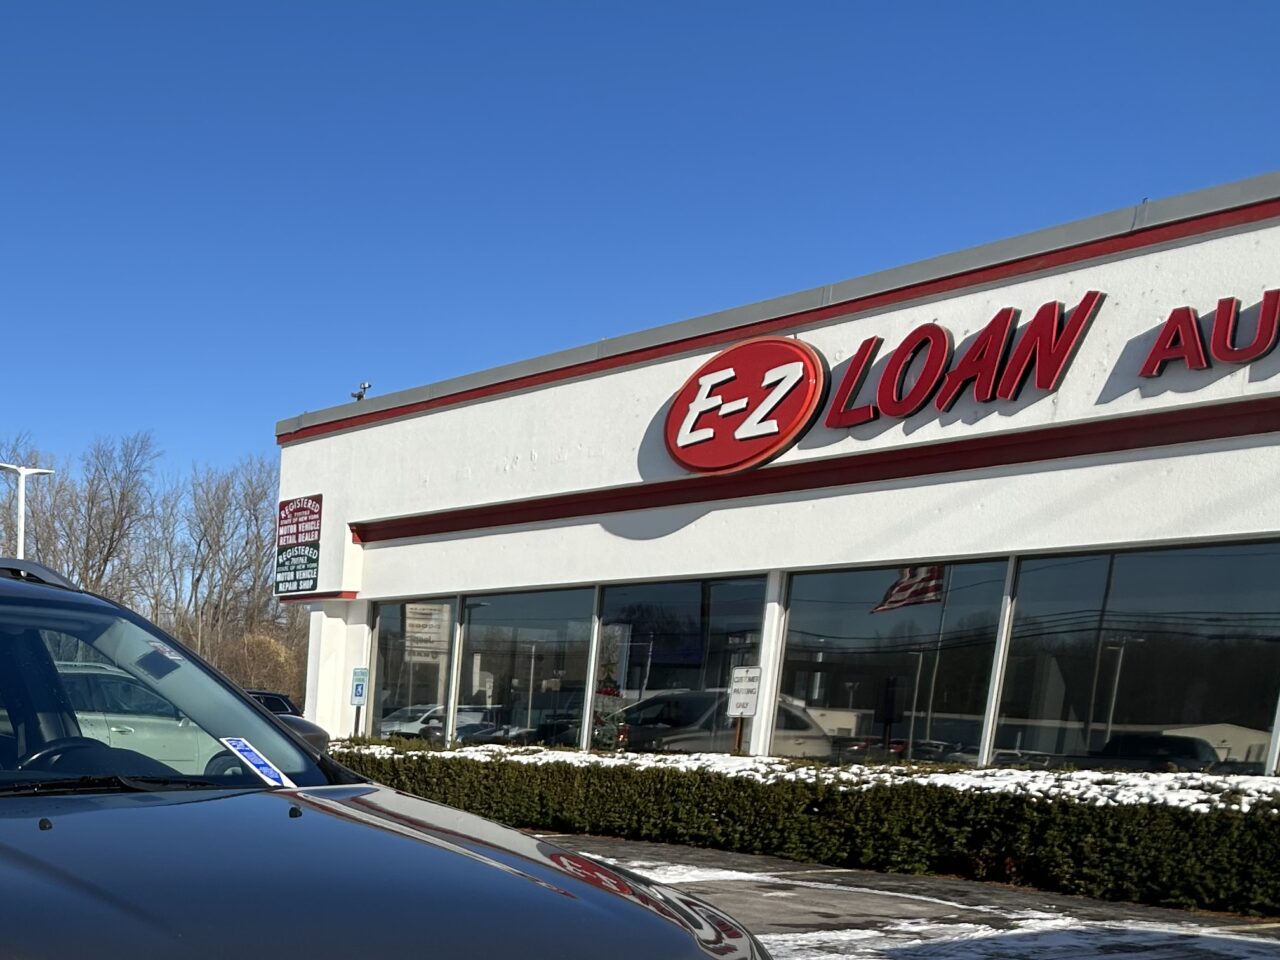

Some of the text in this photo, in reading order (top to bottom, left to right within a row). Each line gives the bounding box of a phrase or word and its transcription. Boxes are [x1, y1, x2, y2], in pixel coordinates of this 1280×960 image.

[675, 361, 804, 448] E-Z
[825, 290, 1106, 429] LOAN
[280, 498, 320, 519] REGISTERED
[279, 520, 320, 535] MOTOR VEHICLE
[279, 531, 319, 546] RETAIL DEALER
[278, 546, 318, 564] REGISTERED
[276, 568, 317, 582] MOTOR VEHICLE
[278, 579, 314, 592] REPAIR SHOP
